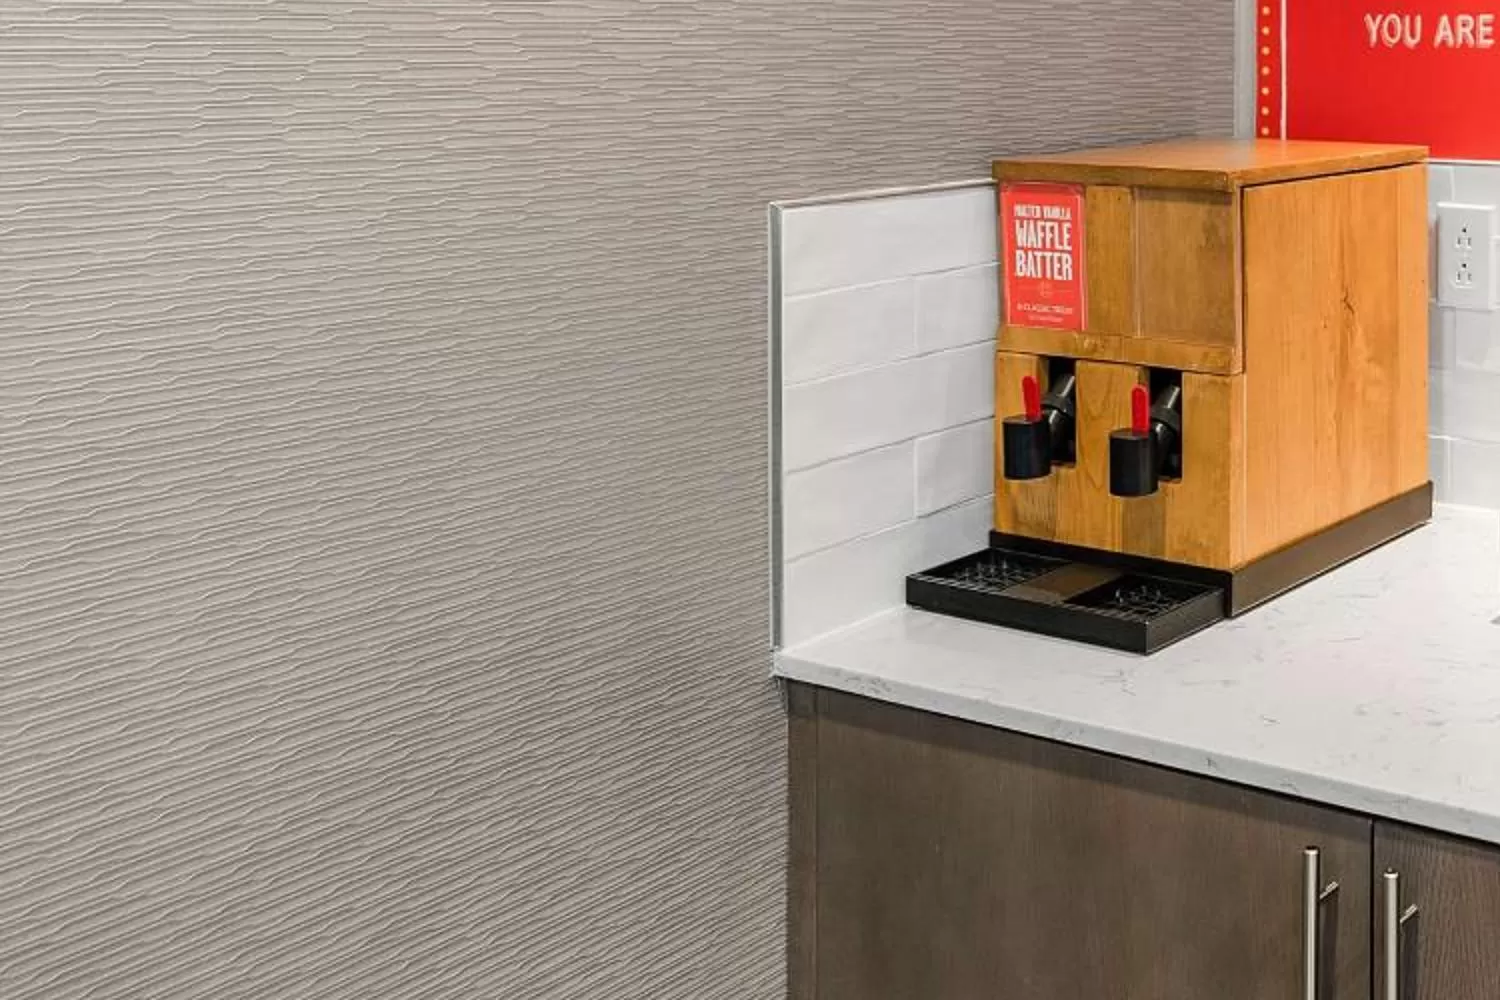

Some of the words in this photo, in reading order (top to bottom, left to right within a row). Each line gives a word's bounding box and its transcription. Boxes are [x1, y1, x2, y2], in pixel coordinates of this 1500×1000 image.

[1362, 13, 1423, 50] YOU
[1433, 14, 1495, 50] ARE
[1014, 219, 1072, 250] WAFFLE
[1015, 250, 1073, 280] BATTER
